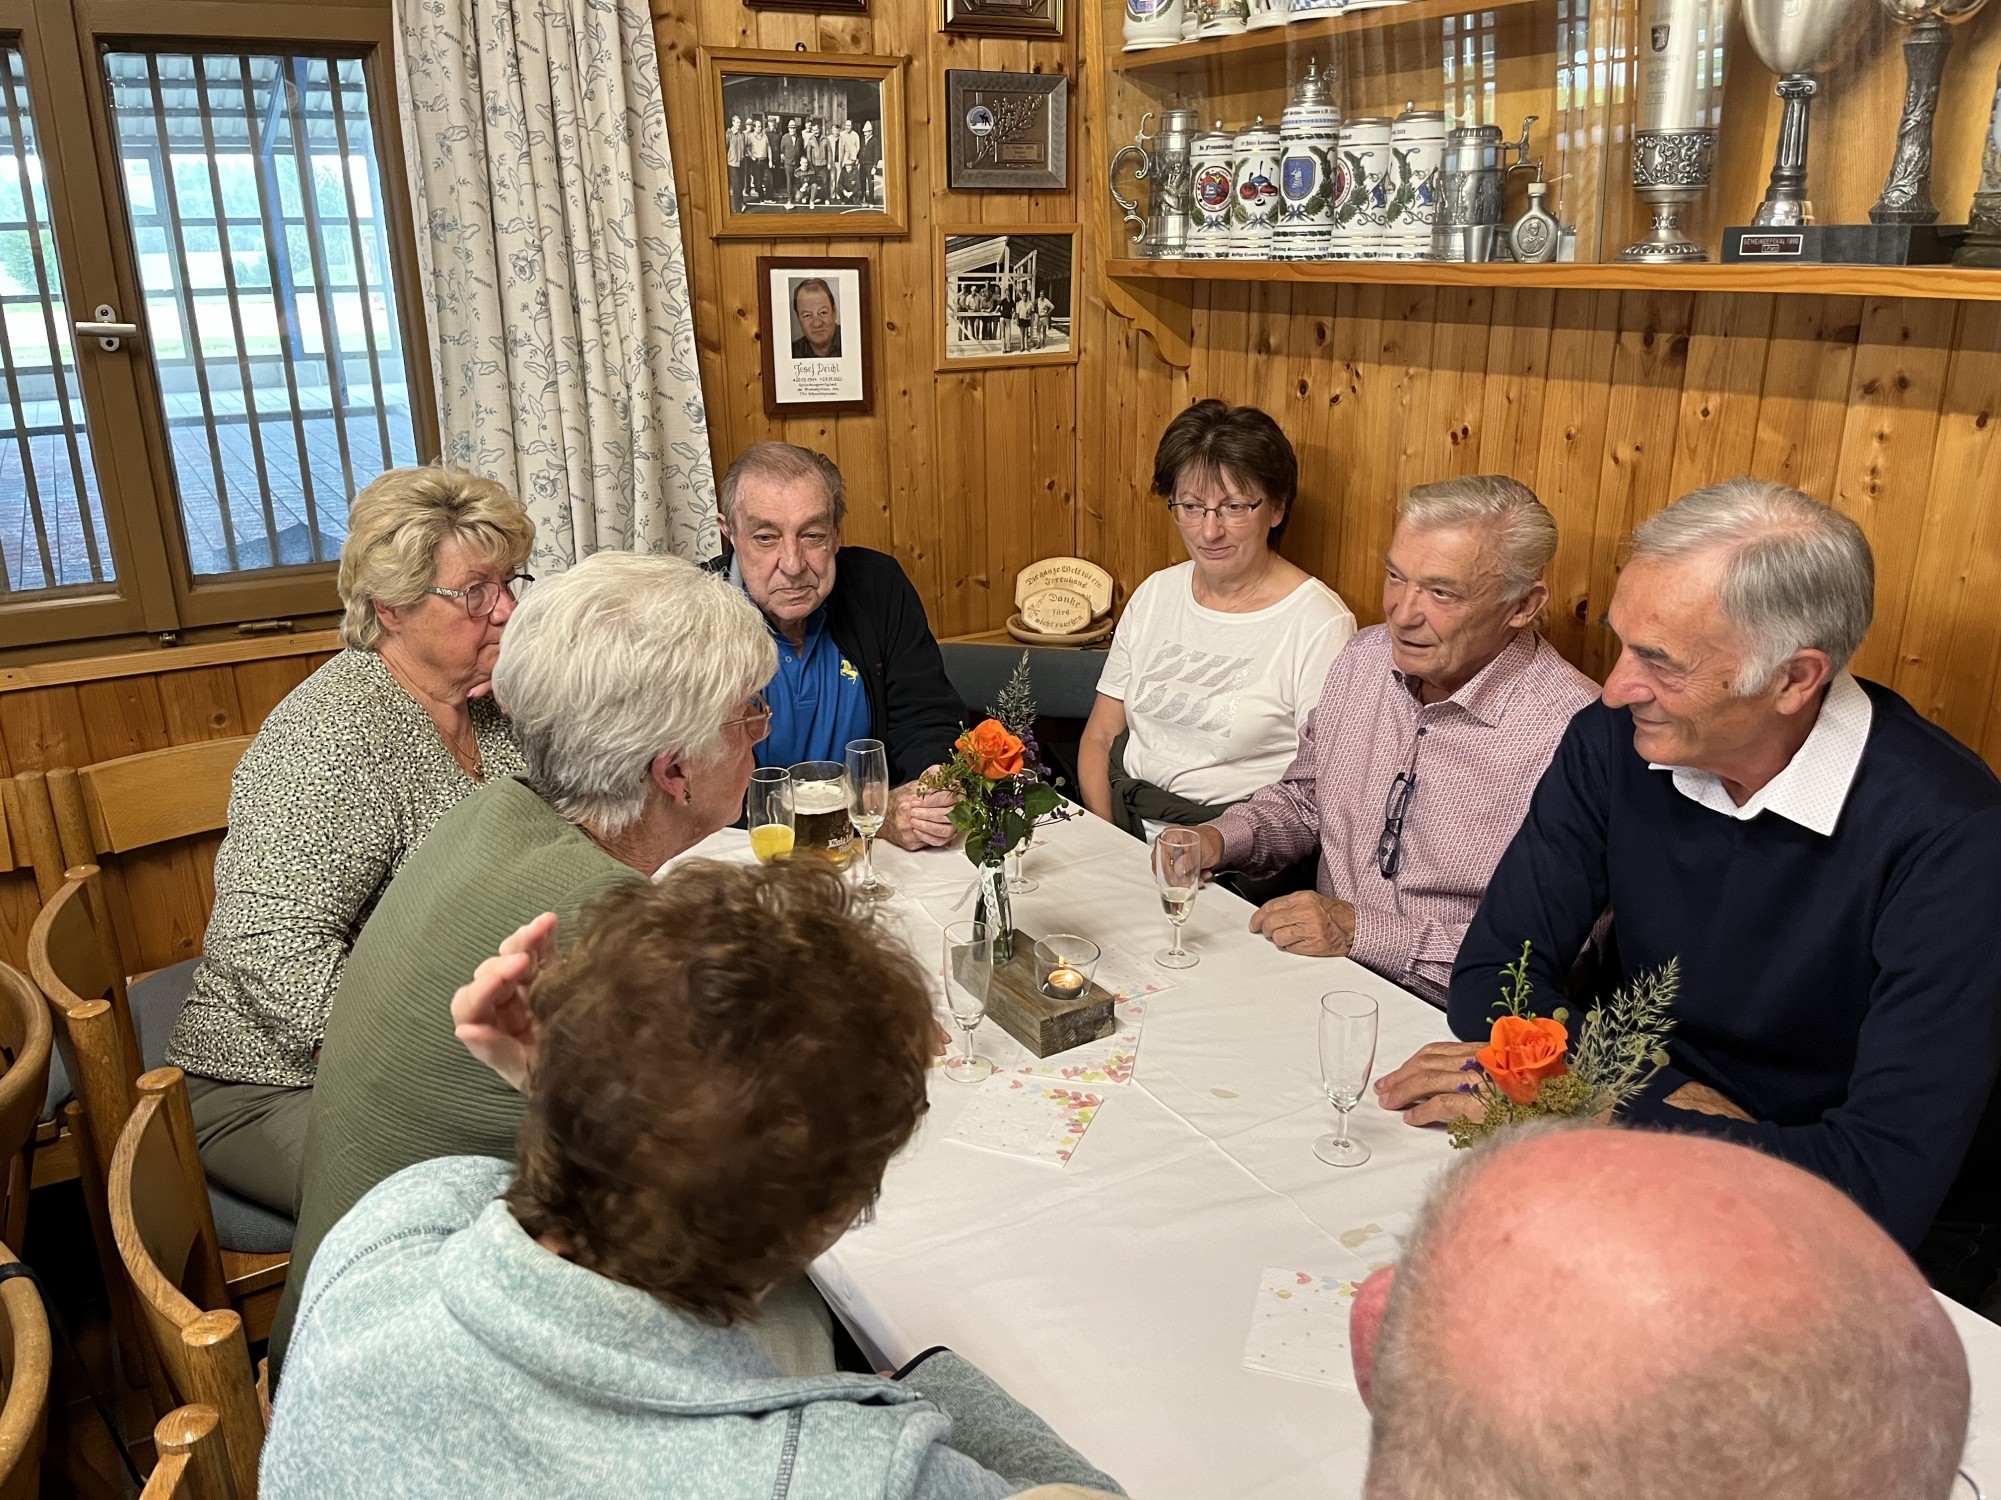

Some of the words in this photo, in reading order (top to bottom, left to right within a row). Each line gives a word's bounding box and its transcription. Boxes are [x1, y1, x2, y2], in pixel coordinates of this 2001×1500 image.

[794, 362, 815, 377] Josef
[1025, 574, 1039, 586] Die
[1039, 567, 1061, 579] ganze
[1061, 565, 1081, 575] Welt
[1081, 571, 1093, 580] ist
[1091, 578, 1102, 589] ein
[1044, 576, 1088, 589] Irrenhaus
[1048, 593, 1081, 608] Danke
[1035, 618, 1054, 628] nicht
[1055, 615, 1083, 628] rauchen
